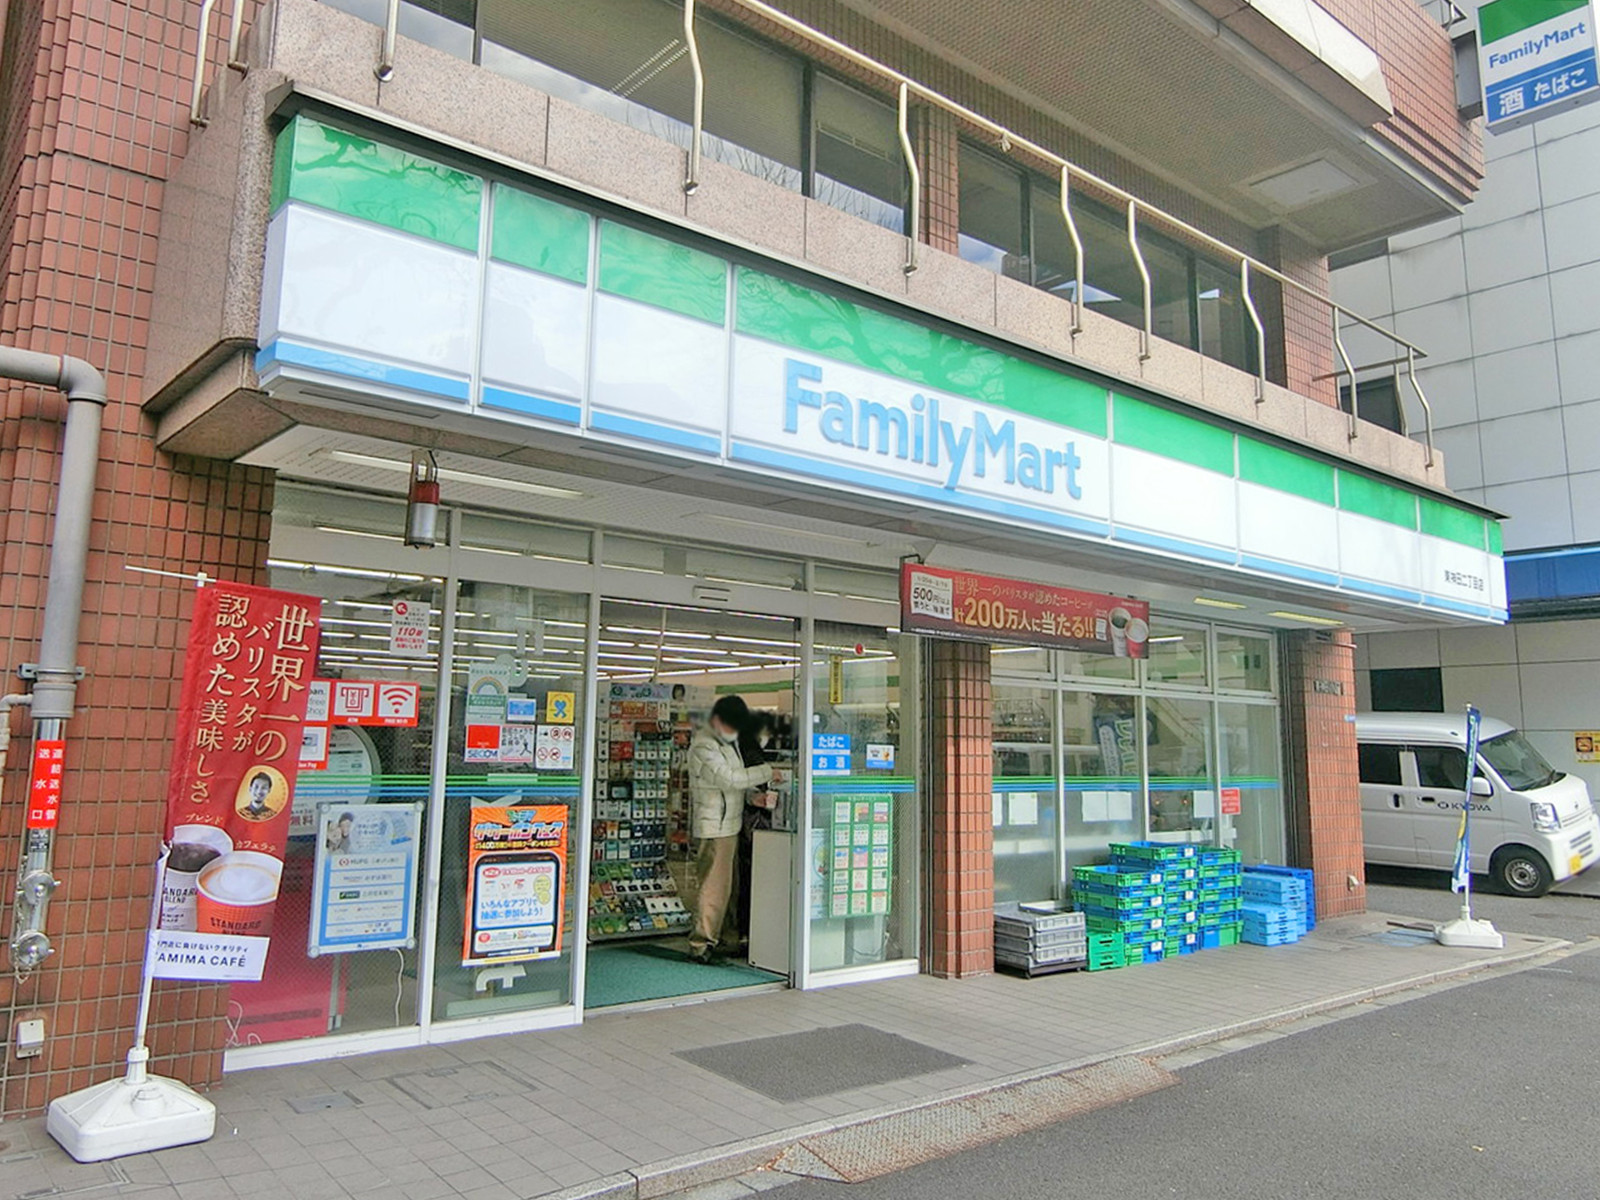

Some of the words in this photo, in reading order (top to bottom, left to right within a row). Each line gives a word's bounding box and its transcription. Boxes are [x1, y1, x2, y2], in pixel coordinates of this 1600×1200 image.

[1488, 22, 1586, 69] FamilyMart
[1499, 86, 1525, 116] 酒
[1534, 68, 1588, 101] たばこ
[783, 357, 1082, 500] FamilyMart
[232, 621, 275, 751] バリスタが
[254, 604, 315, 762] 世界一の
[467, 750, 498, 758] SECOM
[818, 735, 845, 748] たばこ
[186, 813, 223, 825] ブレンド
[156, 951, 206, 964] AMIMA
[210, 954, 246, 967] CAFÉ
[157, 940, 248, 953] 門店に負けないクオリティ
